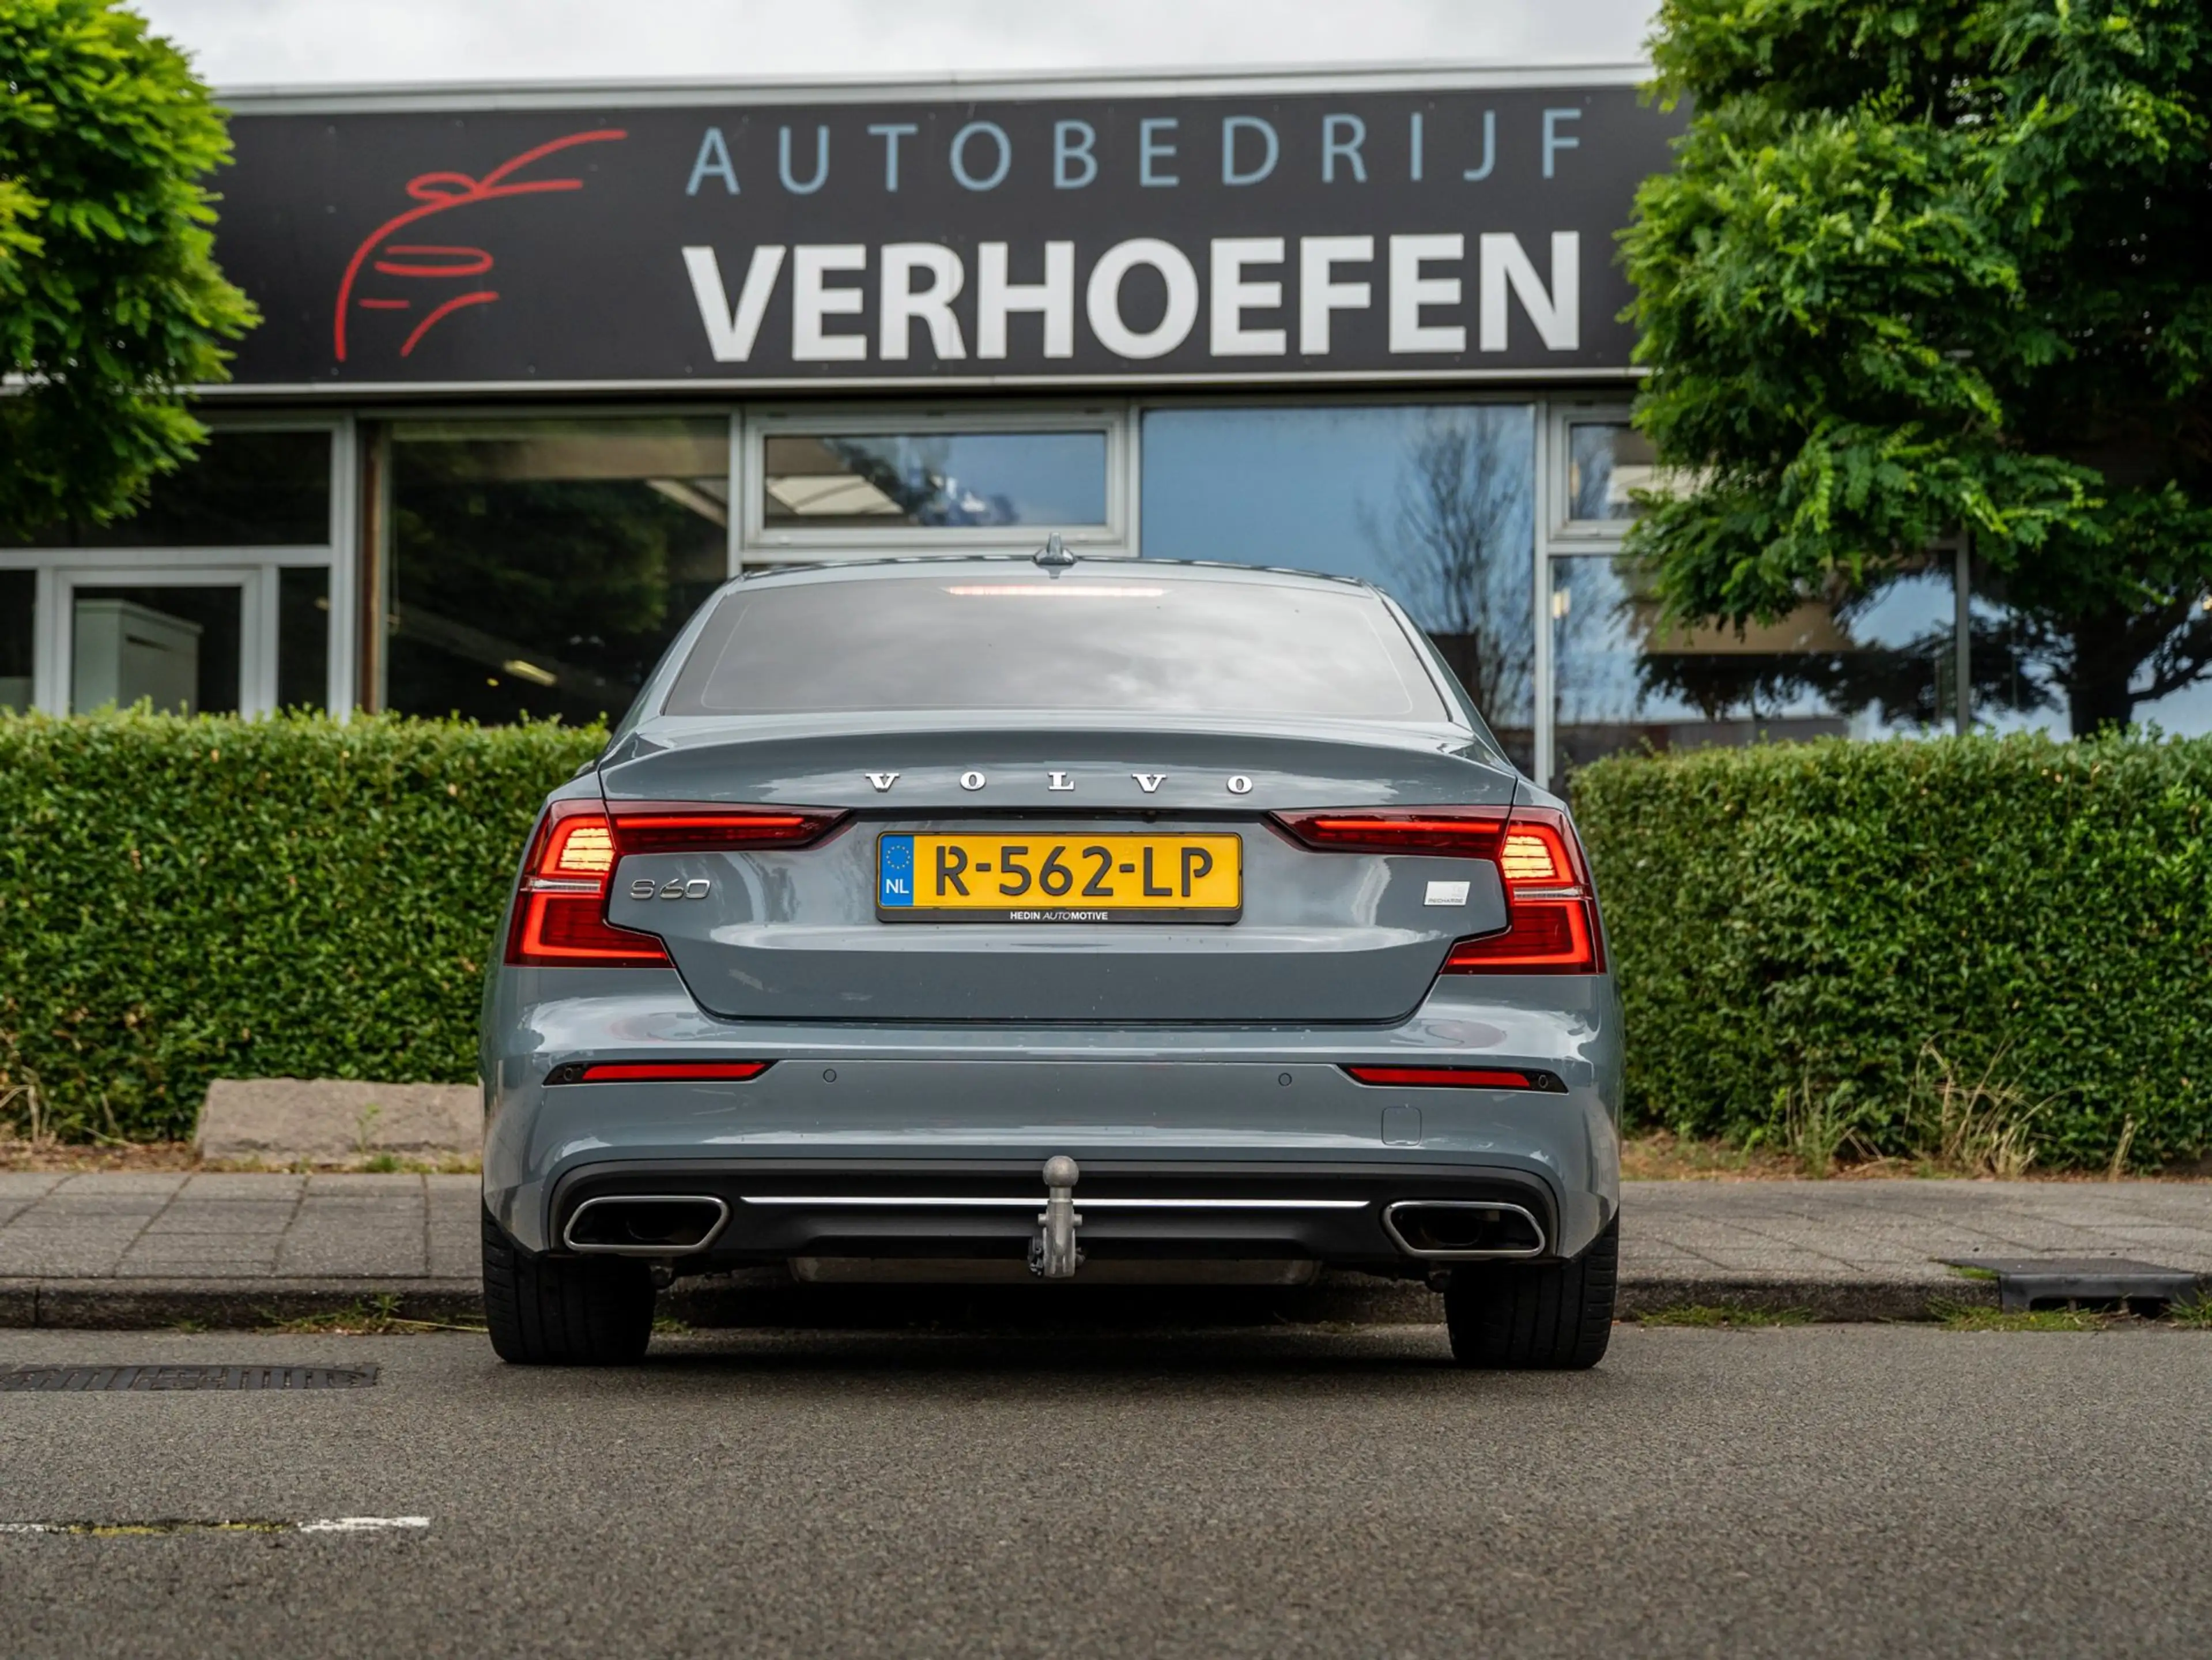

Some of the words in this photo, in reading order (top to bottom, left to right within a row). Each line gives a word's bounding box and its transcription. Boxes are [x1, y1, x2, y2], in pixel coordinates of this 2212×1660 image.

[686, 108, 1581, 195] AUTOBEDRIJF
[681, 231, 1580, 363] VERHOEFEN
[865, 771, 1253, 794] VOLVO
[935, 845, 1213, 897] R-562-LP
[630, 878, 711, 899] S60
[885, 878, 909, 894] NL
[1010, 911, 1040, 920] HEDIN
[1042, 911, 1108, 920] AUTOMOTIVE
